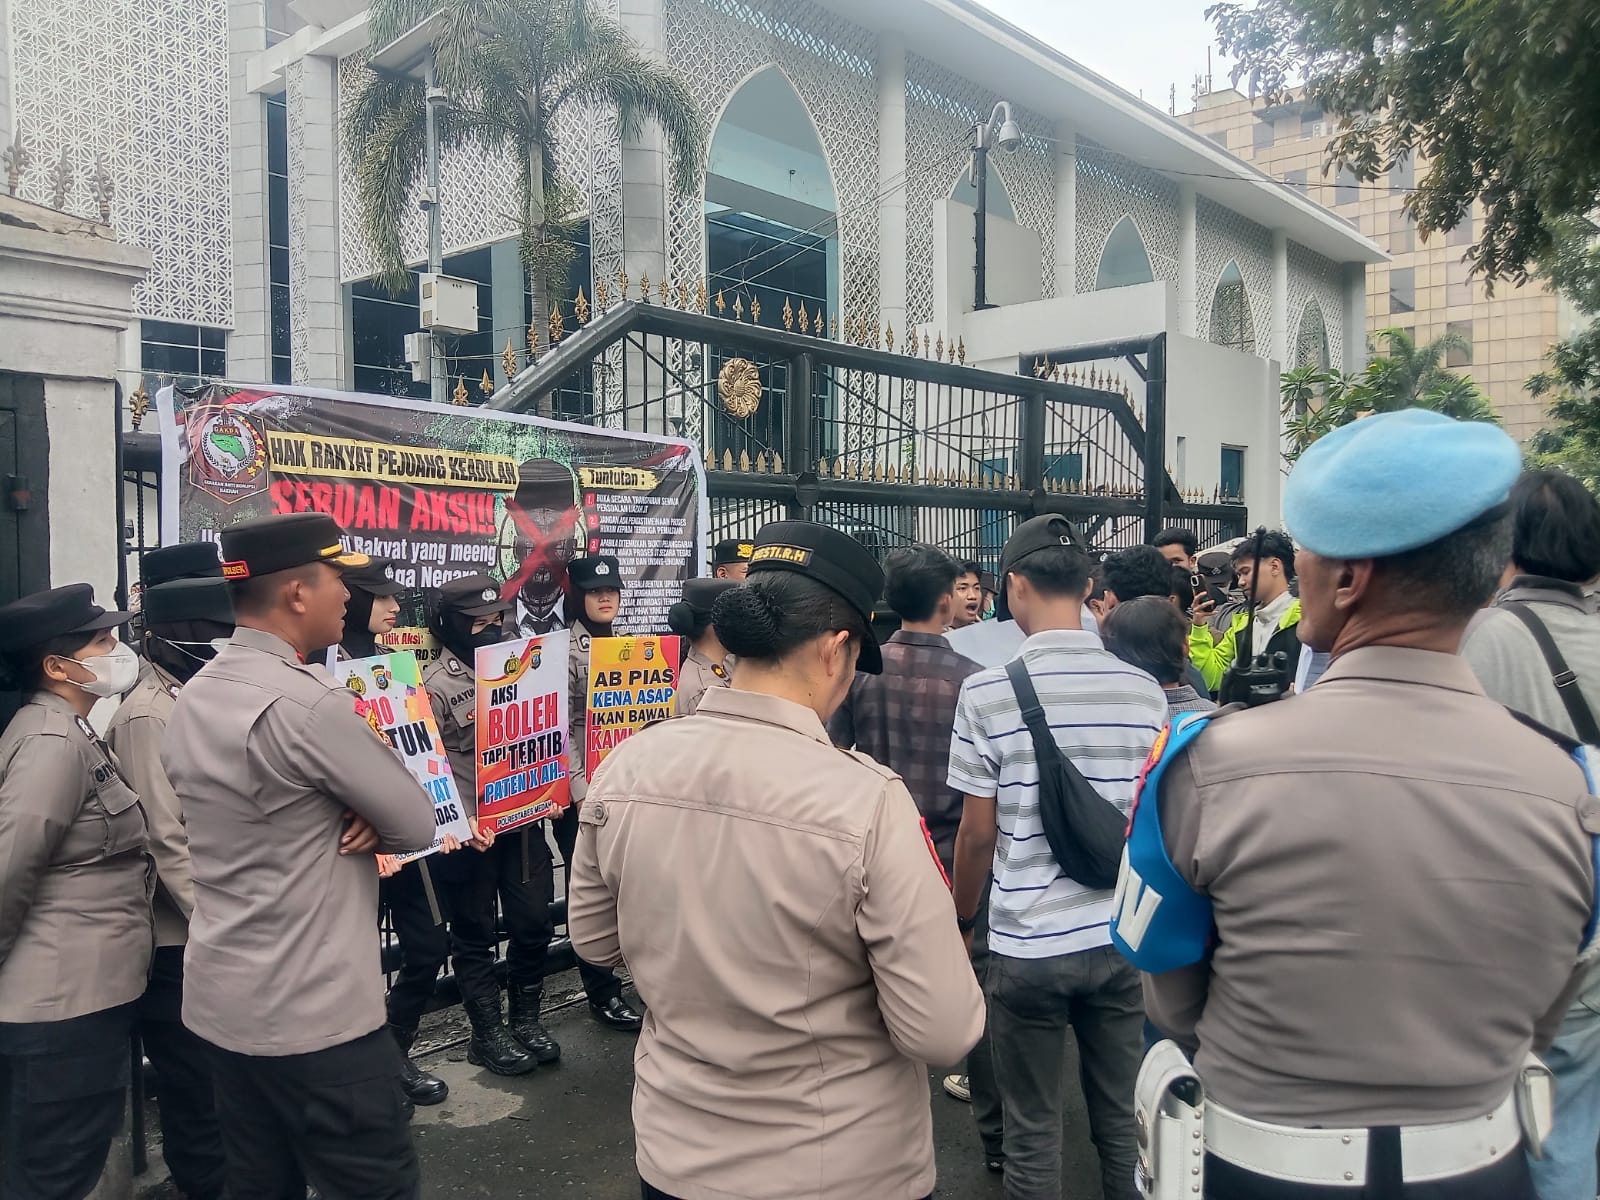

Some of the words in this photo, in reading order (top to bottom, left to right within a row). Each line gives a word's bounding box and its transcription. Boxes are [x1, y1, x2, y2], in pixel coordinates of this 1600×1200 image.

[270, 437, 307, 467] HAK
[310, 440, 373, 472] RAKYAT
[378, 448, 447, 479] PEJUANG
[449, 456, 517, 484] KEADILAN
[588, 469, 638, 486] Tuntutan
[411, 542, 447, 565] yang
[450, 543, 497, 566] meeng
[380, 632, 400, 645] Titik
[401, 632, 424, 645] Aksi:
[594, 670, 622, 687] AB
[628, 668, 674, 686] PIAS
[490, 683, 518, 706] AKSI
[592, 690, 632, 708] KENA
[636, 687, 674, 705] ASAP
[488, 691, 559, 746] BOLEH
[591, 709, 625, 726] IKAN
[628, 707, 673, 723] BAWAL
[386, 721, 434, 757] TUN
[482, 745, 507, 767] TAPI
[508, 730, 562, 770] TERTIB
[485, 771, 527, 805] PATEN
[528, 766, 540, 790] X
[540, 760, 565, 786] AH..
[496, 807, 534, 828] POLRESTABES
